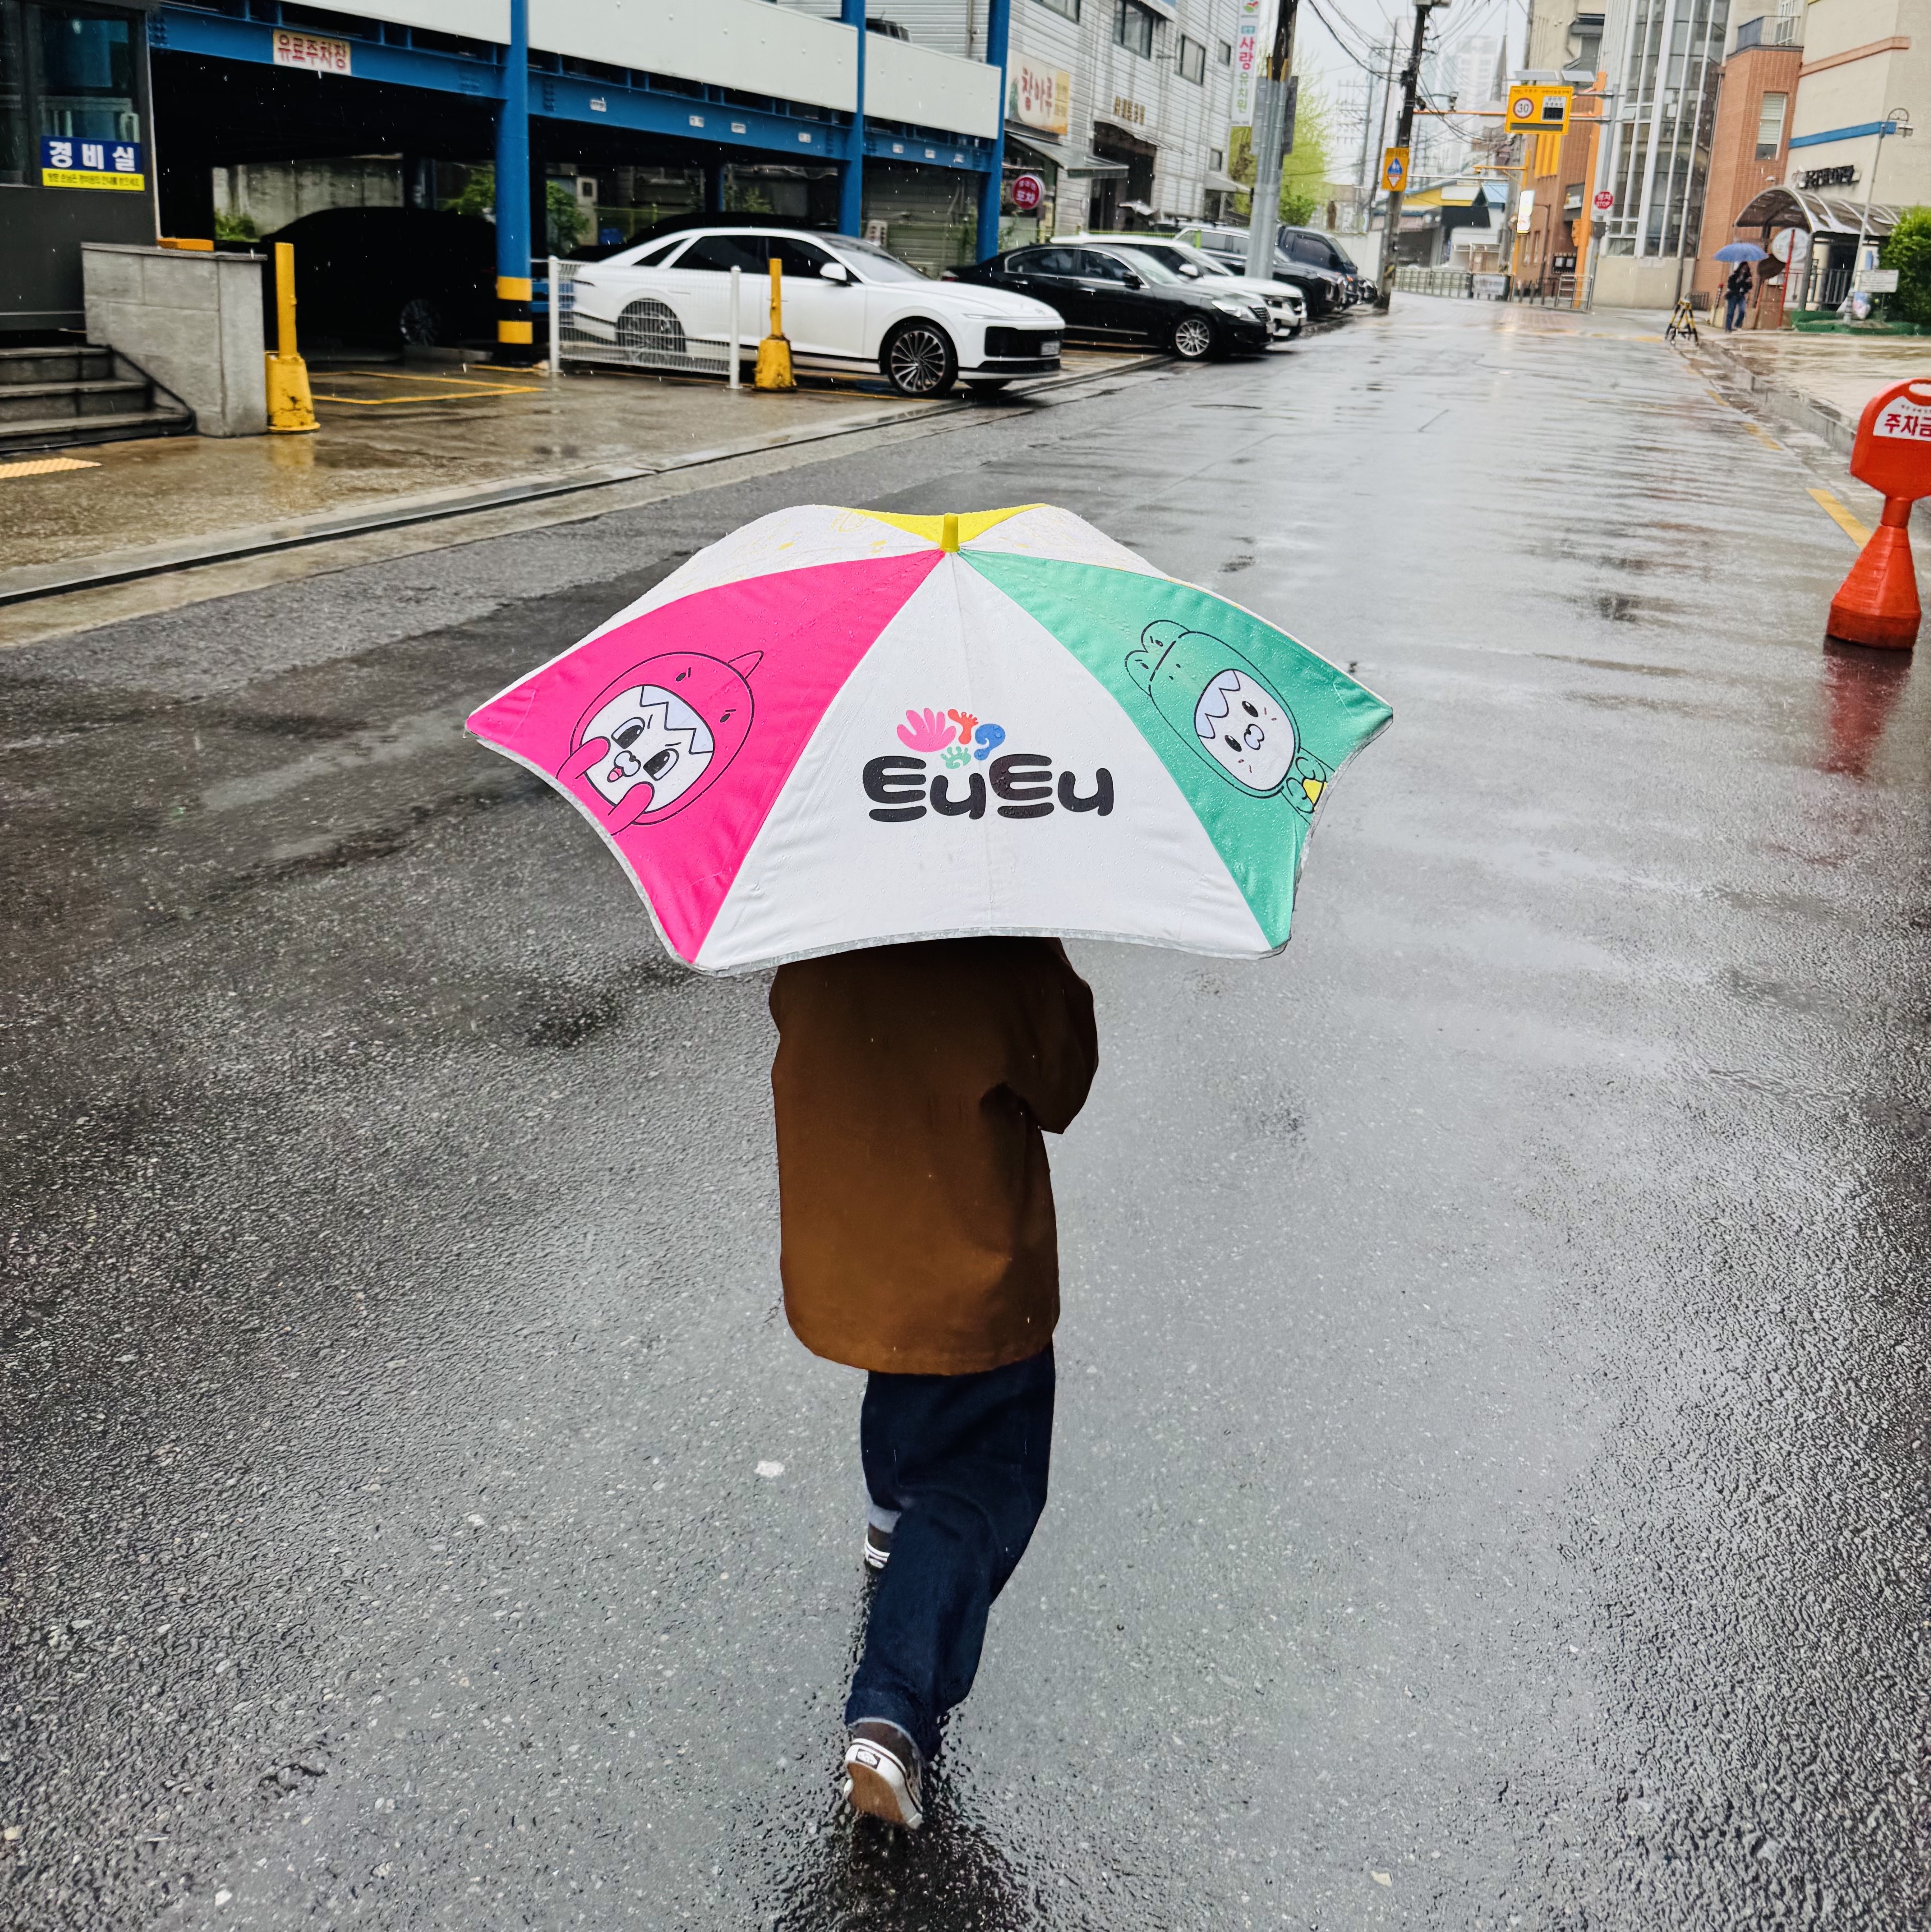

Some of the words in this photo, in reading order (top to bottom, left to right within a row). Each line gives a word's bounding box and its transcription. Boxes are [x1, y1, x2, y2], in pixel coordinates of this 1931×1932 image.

[278, 33, 346, 69] 유료주차장
[1239, 36, 1254, 70] 사랑
[1237, 72, 1249, 114] 유치원
[1517, 103, 1529, 113] 30
[49, 141, 135, 172] 경비실
[862, 753, 1114, 822] EuEu
